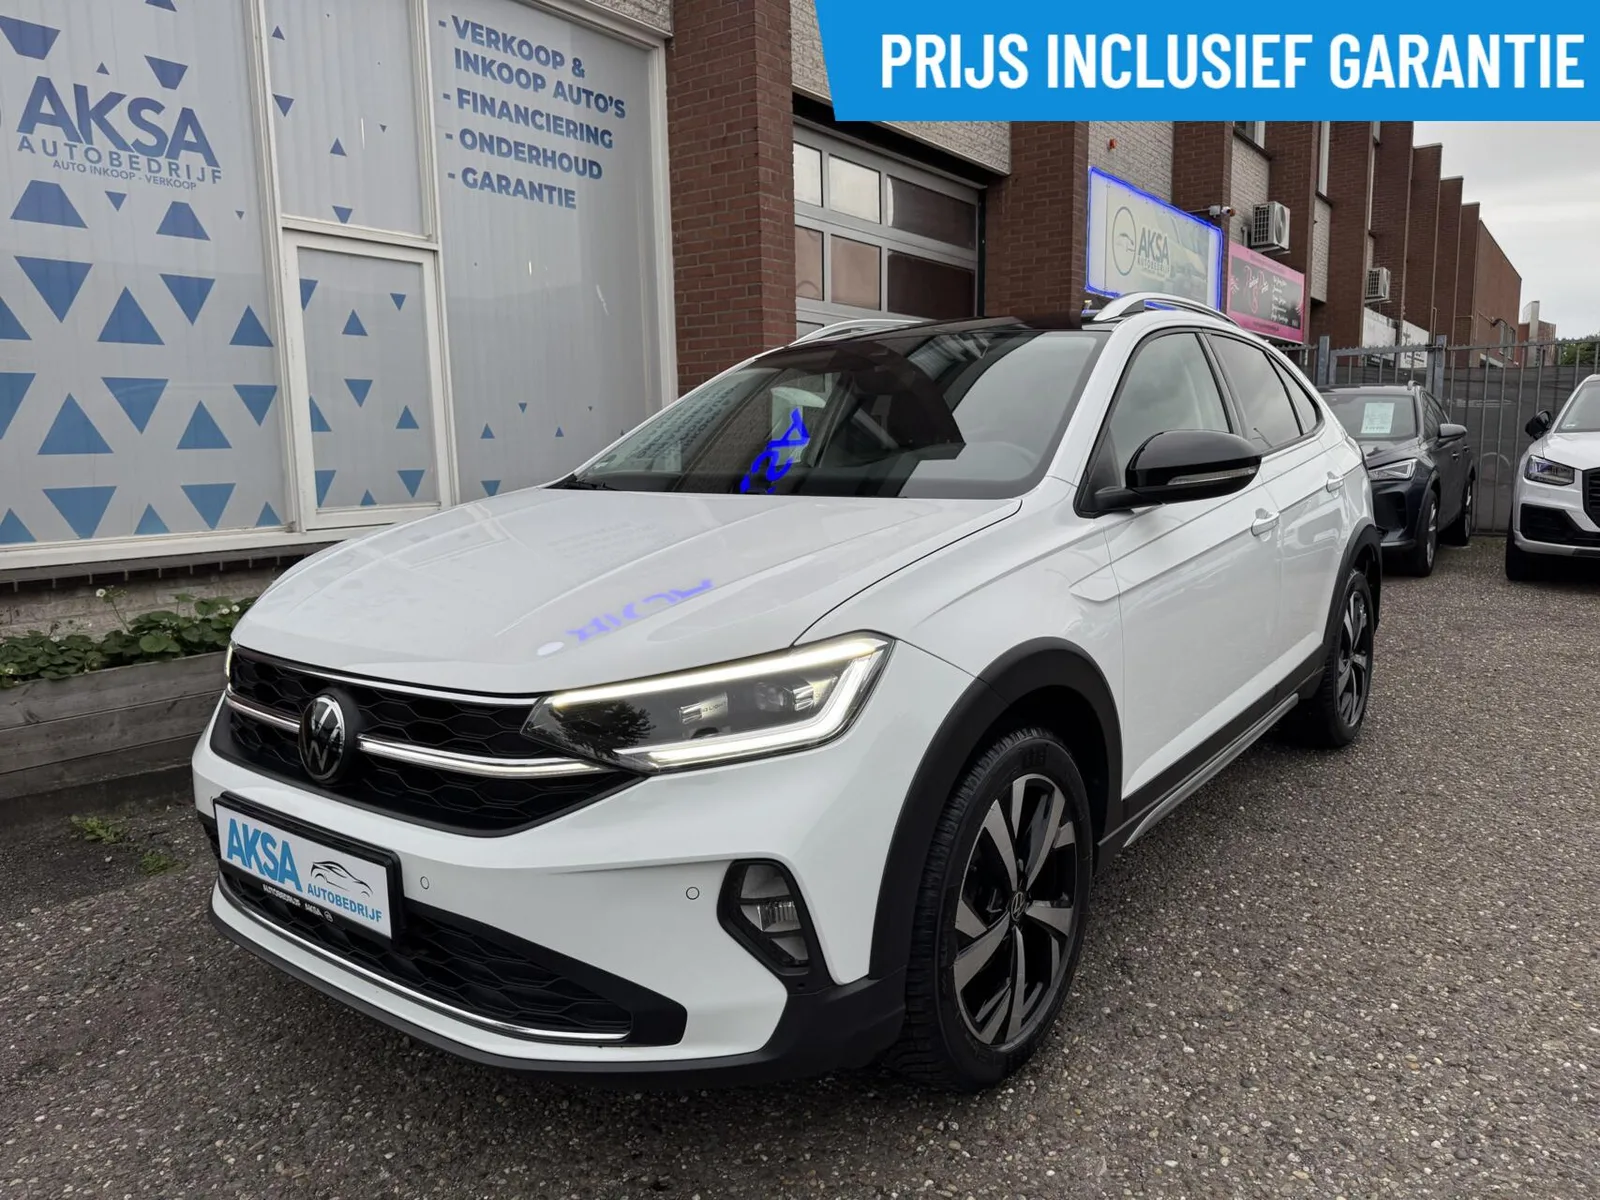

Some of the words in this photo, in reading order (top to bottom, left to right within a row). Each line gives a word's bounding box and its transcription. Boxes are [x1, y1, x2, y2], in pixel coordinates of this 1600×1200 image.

[451, 15, 565, 71] VERKOOP
[571, 57, 586, 79] &
[454, 48, 546, 93] INKOOP
[552, 80, 627, 119] AUTO'S
[17, 76, 221, 168] AKSA
[456, 88, 614, 149] FINANCIERING
[17, 135, 222, 185] AUTOBEDRIJF
[53, 159, 87, 174] AUTO
[90, 165, 136, 181] INKOOP
[145, 174, 197, 191] VERKOOP
[459, 128, 603, 180] ONDERHOUD
[461, 167, 577, 210] GARANTIE
[1138, 227, 1169, 265] AKSA
[227, 818, 303, 893] AKSA
[308, 883, 383, 923] AUTOBEDRIJF
